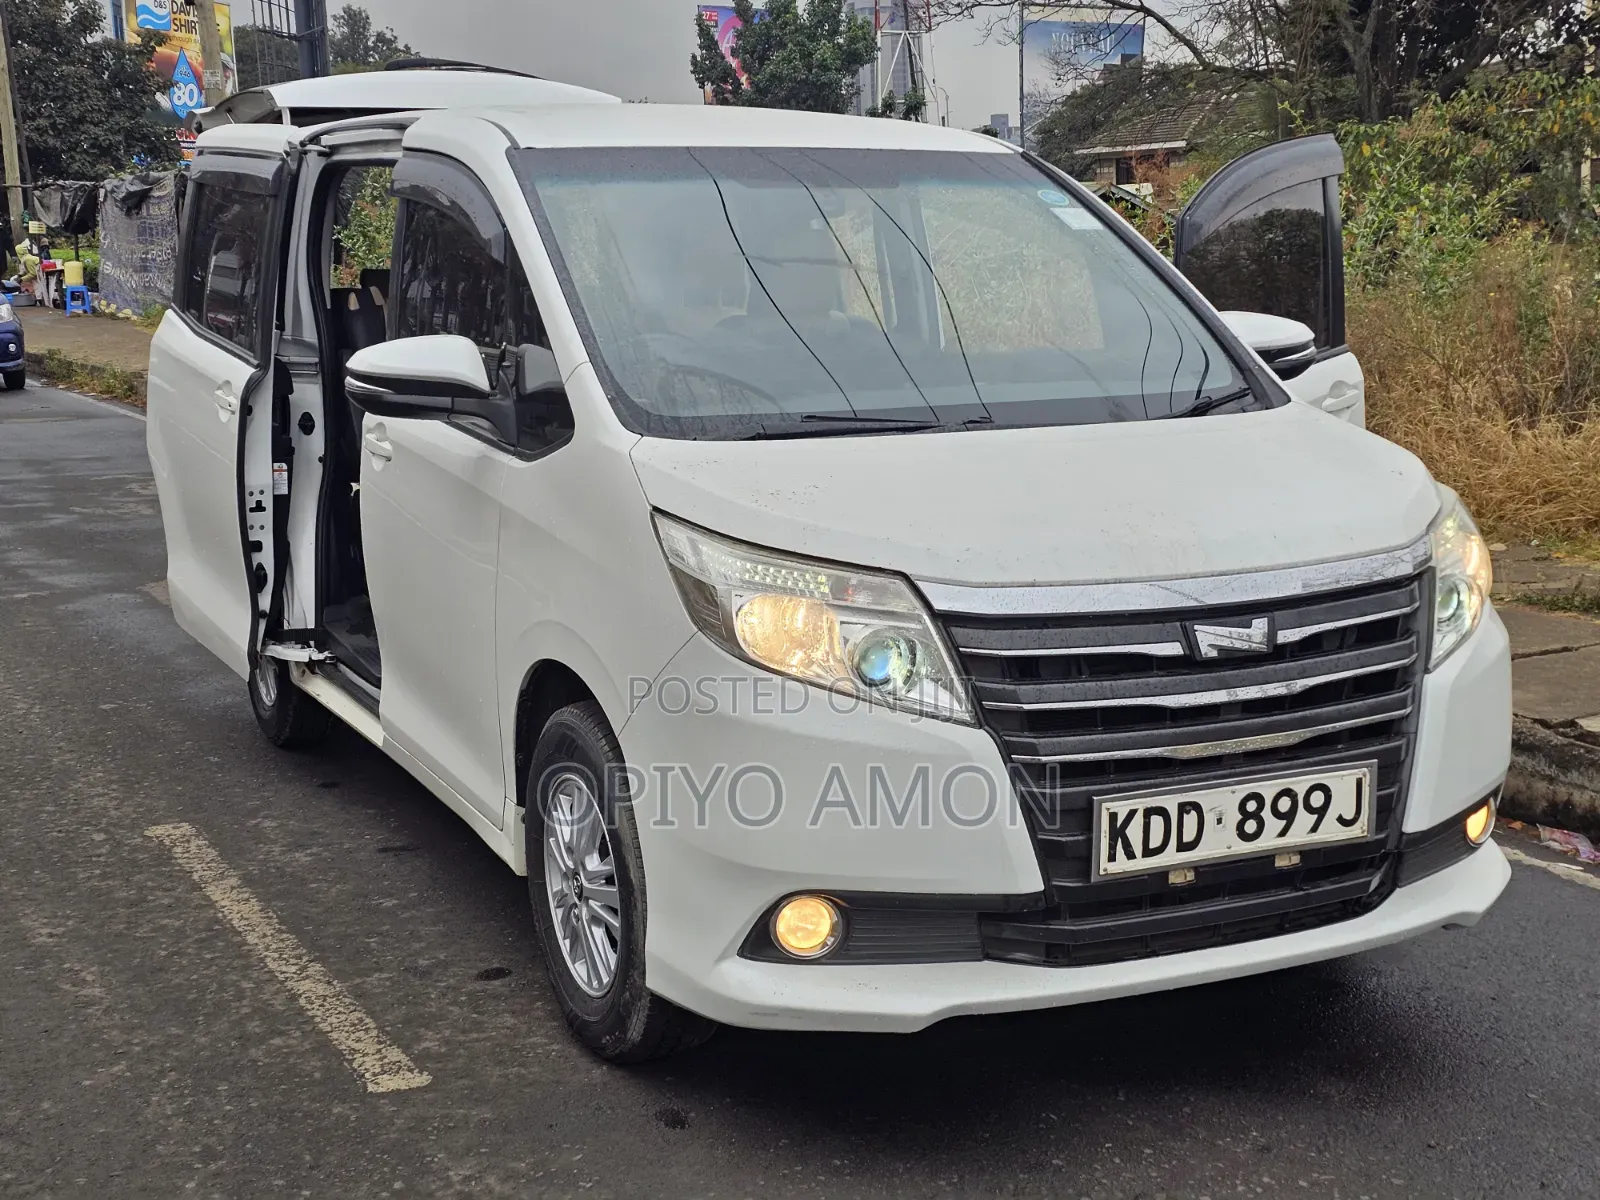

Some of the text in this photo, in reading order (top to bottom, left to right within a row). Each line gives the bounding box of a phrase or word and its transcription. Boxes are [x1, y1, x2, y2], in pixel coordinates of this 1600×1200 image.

[172, 18, 199, 35] SHIR
[173, 82, 199, 107] 80
[1106, 777, 1363, 863] KDD 899J
